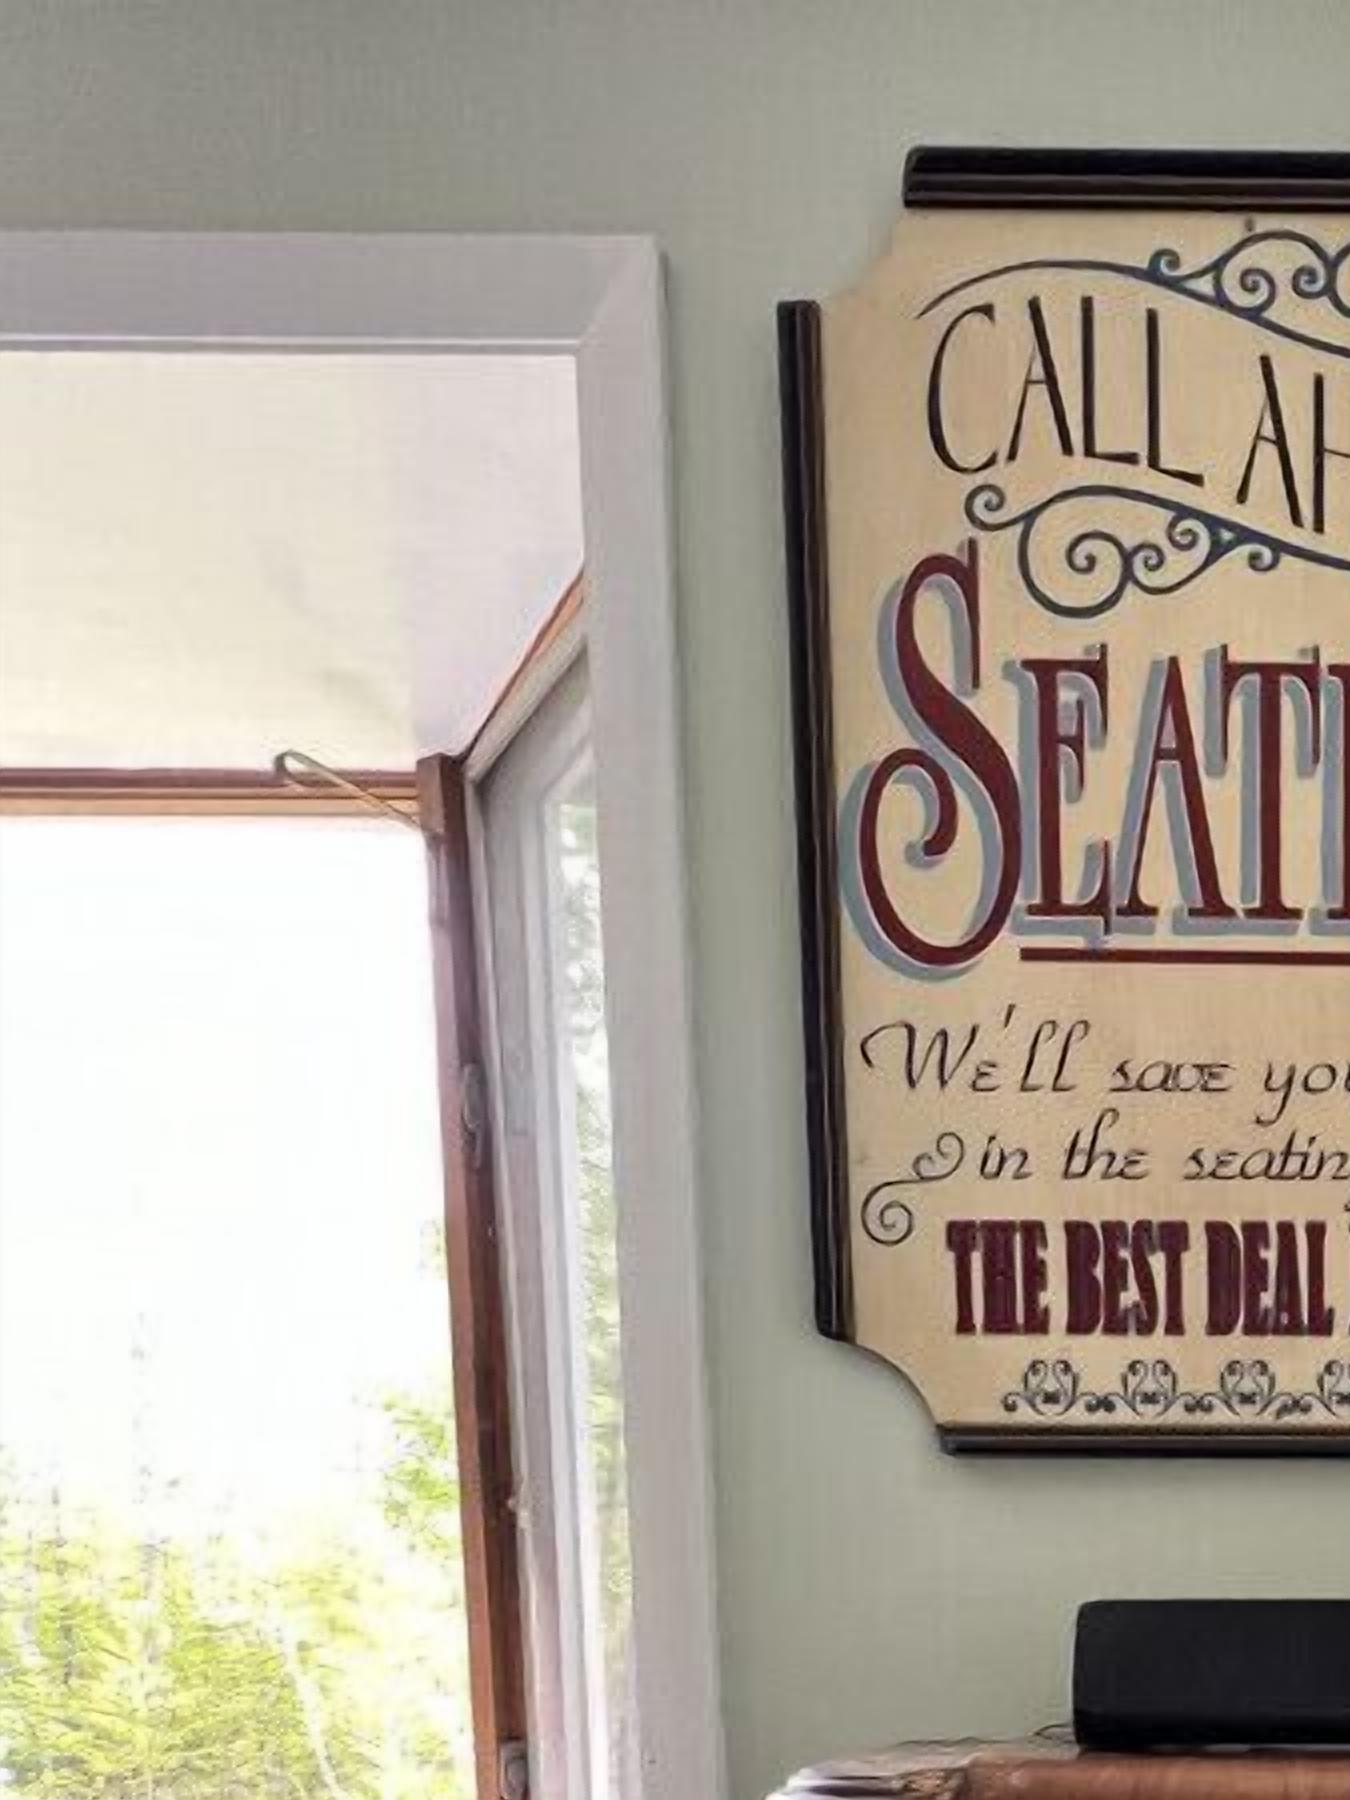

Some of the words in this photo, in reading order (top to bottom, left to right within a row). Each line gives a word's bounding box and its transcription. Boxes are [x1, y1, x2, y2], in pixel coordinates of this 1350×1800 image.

[926, 296, 1206, 487] CALL
[860, 1004, 1090, 1092] We'll
[1109, 1058, 1235, 1093] save
[980, 1134, 1032, 1181] in
[1062, 1108, 1149, 1181] the
[946, 1220, 1050, 1335] THE
[1064, 1219, 1190, 1335] BEST
[1204, 1221, 1334, 1336] DEAL
